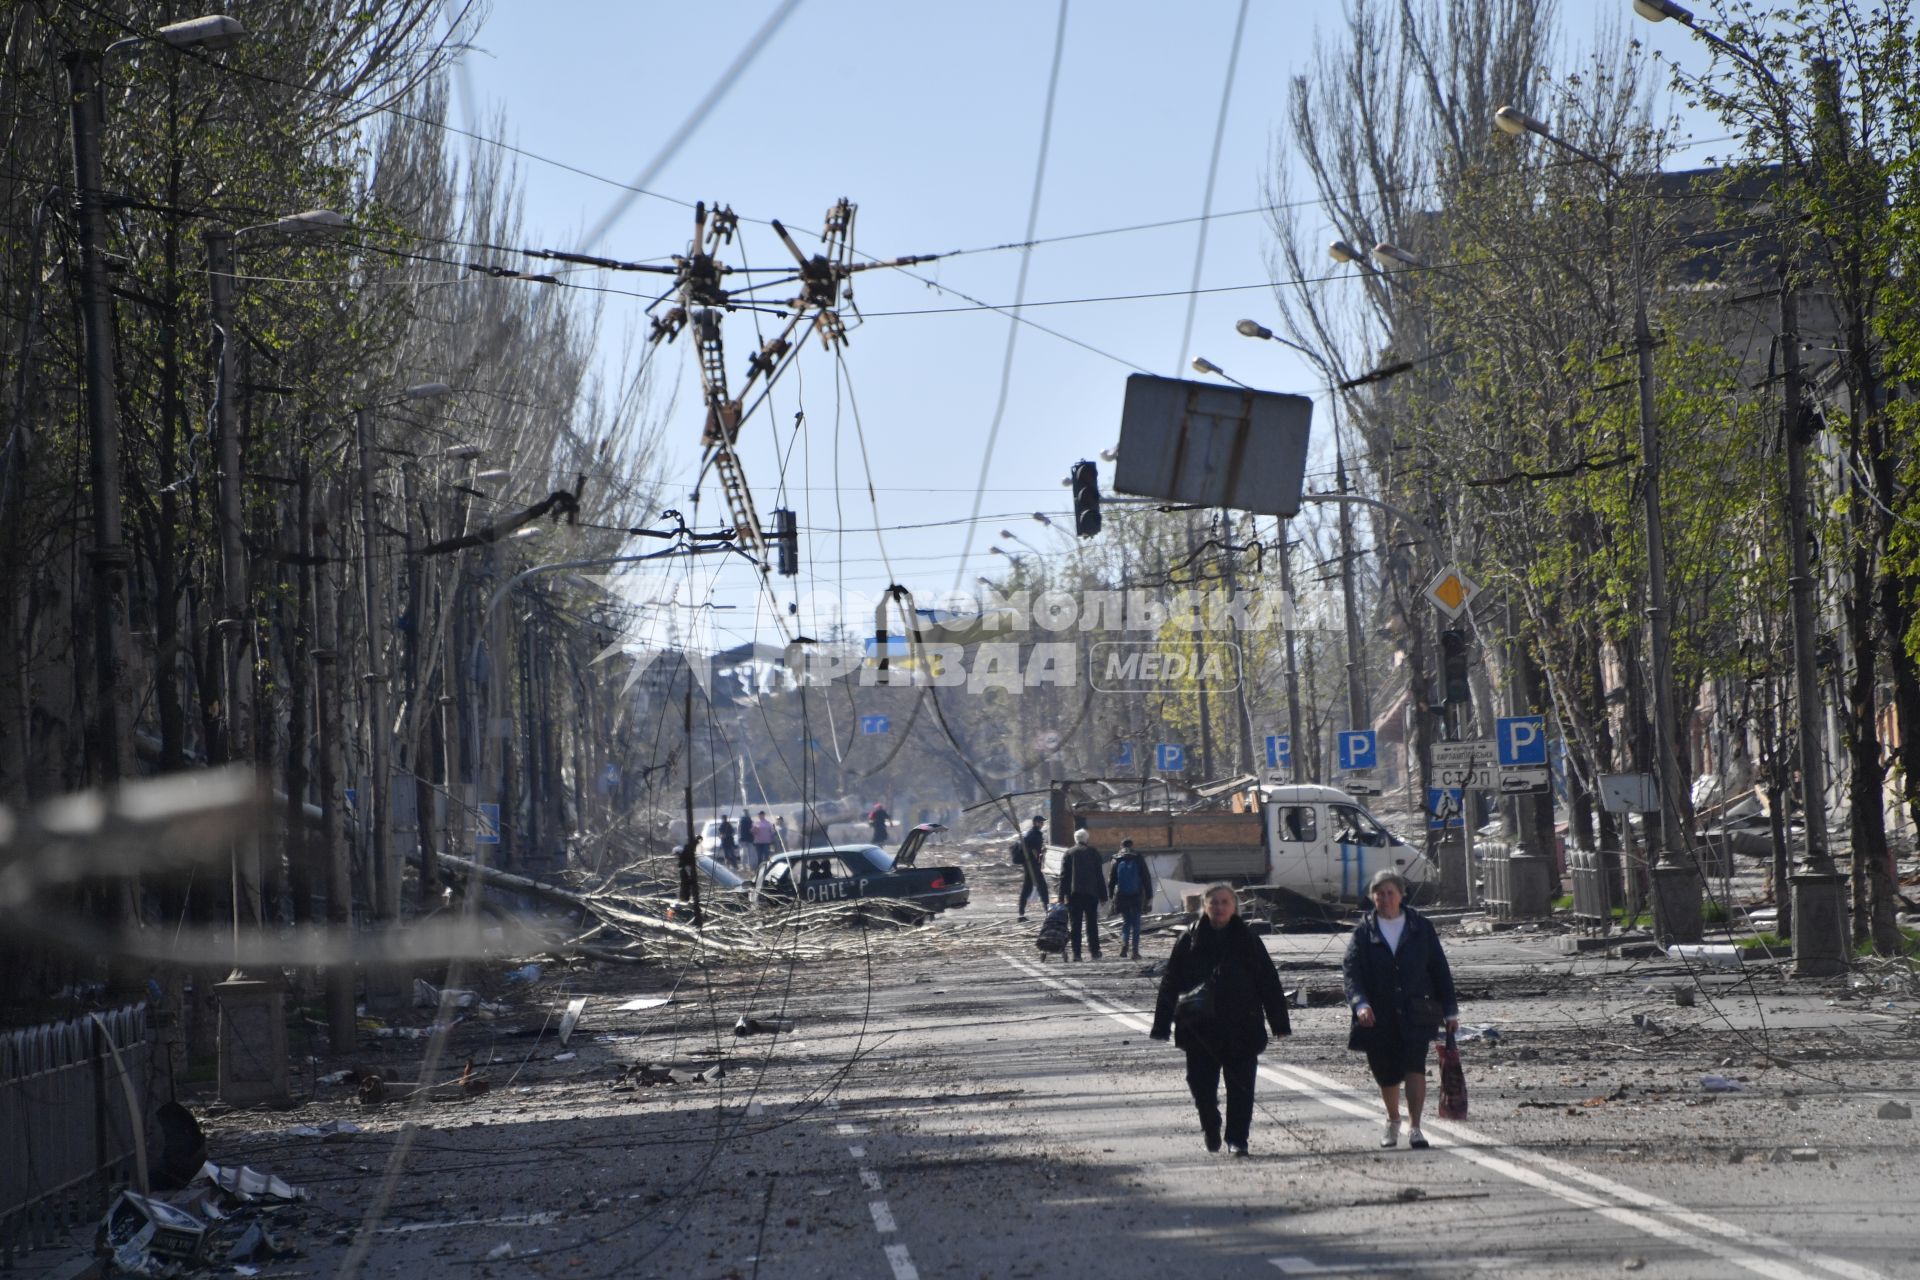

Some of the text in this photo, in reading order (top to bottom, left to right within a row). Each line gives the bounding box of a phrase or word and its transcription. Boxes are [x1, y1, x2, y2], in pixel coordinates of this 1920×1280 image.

[1350, 735, 1369, 765] P
[1510, 722, 1536, 760] P
[1164, 746, 1180, 768] P
[1442, 771, 1490, 785] СТОП
